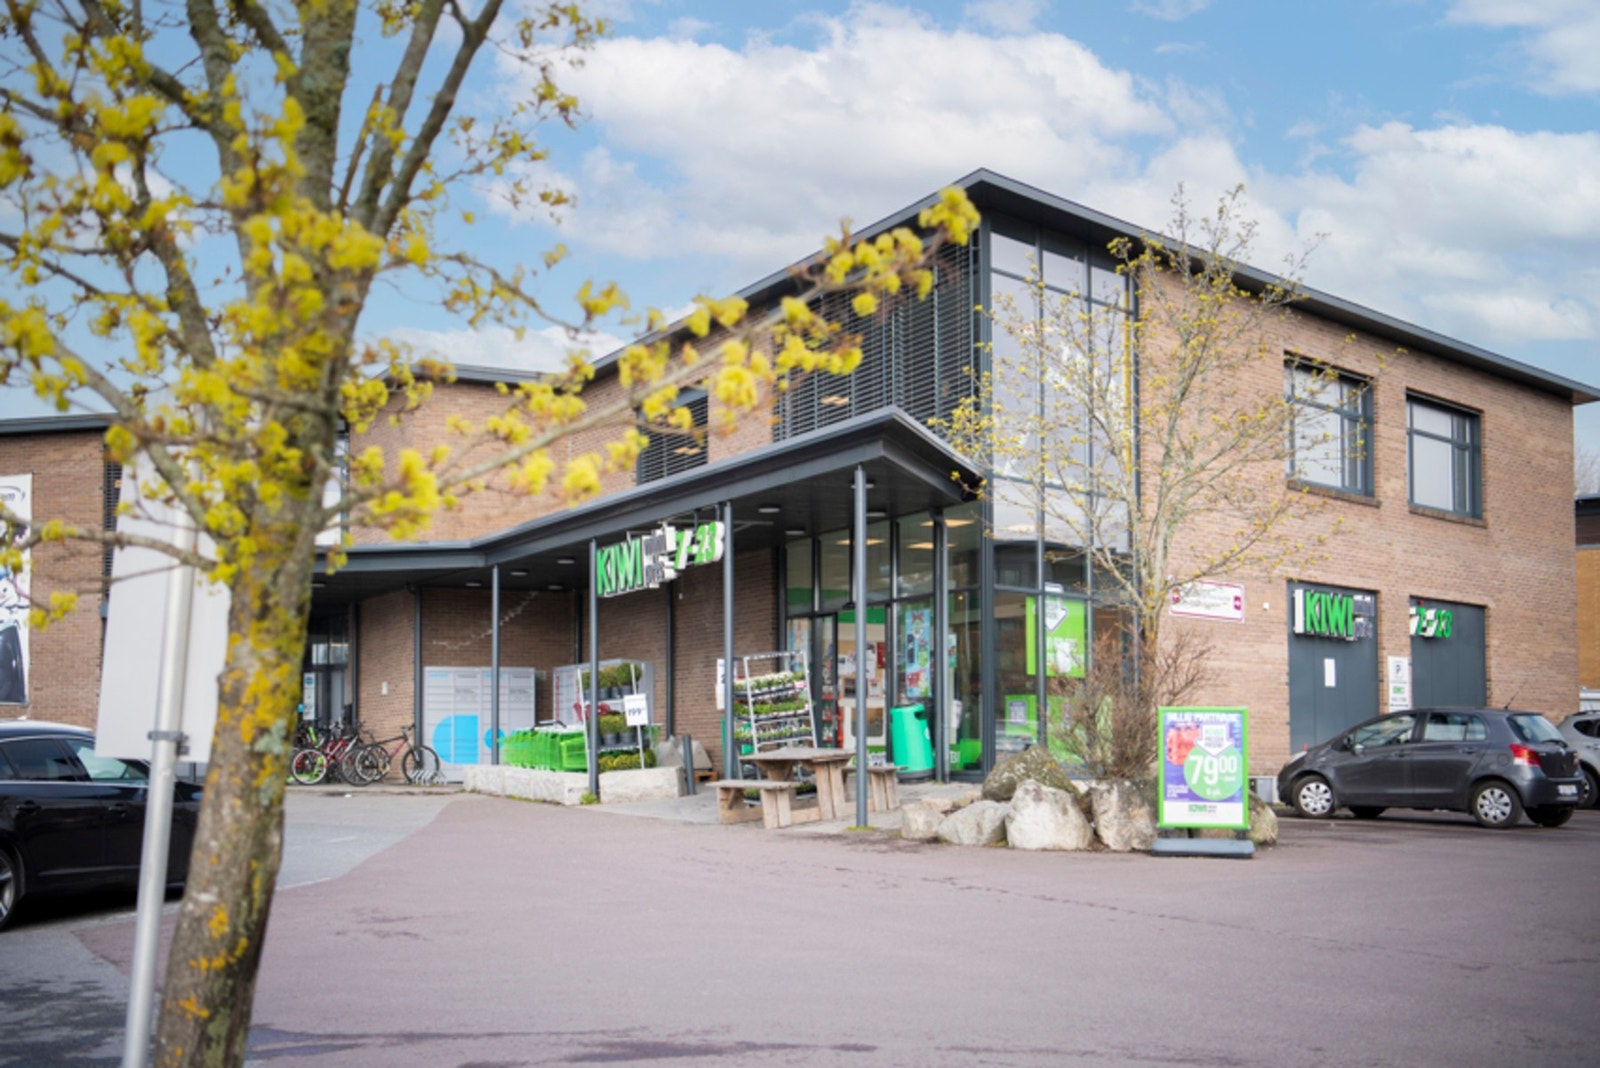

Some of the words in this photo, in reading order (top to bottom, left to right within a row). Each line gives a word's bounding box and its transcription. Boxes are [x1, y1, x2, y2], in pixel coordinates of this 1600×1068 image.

[596, 537, 643, 596] KIWI
[674, 521, 724, 570] 7-23
[1304, 590, 1354, 637] KIWI
[1416, 606, 1453, 638] 7-23
